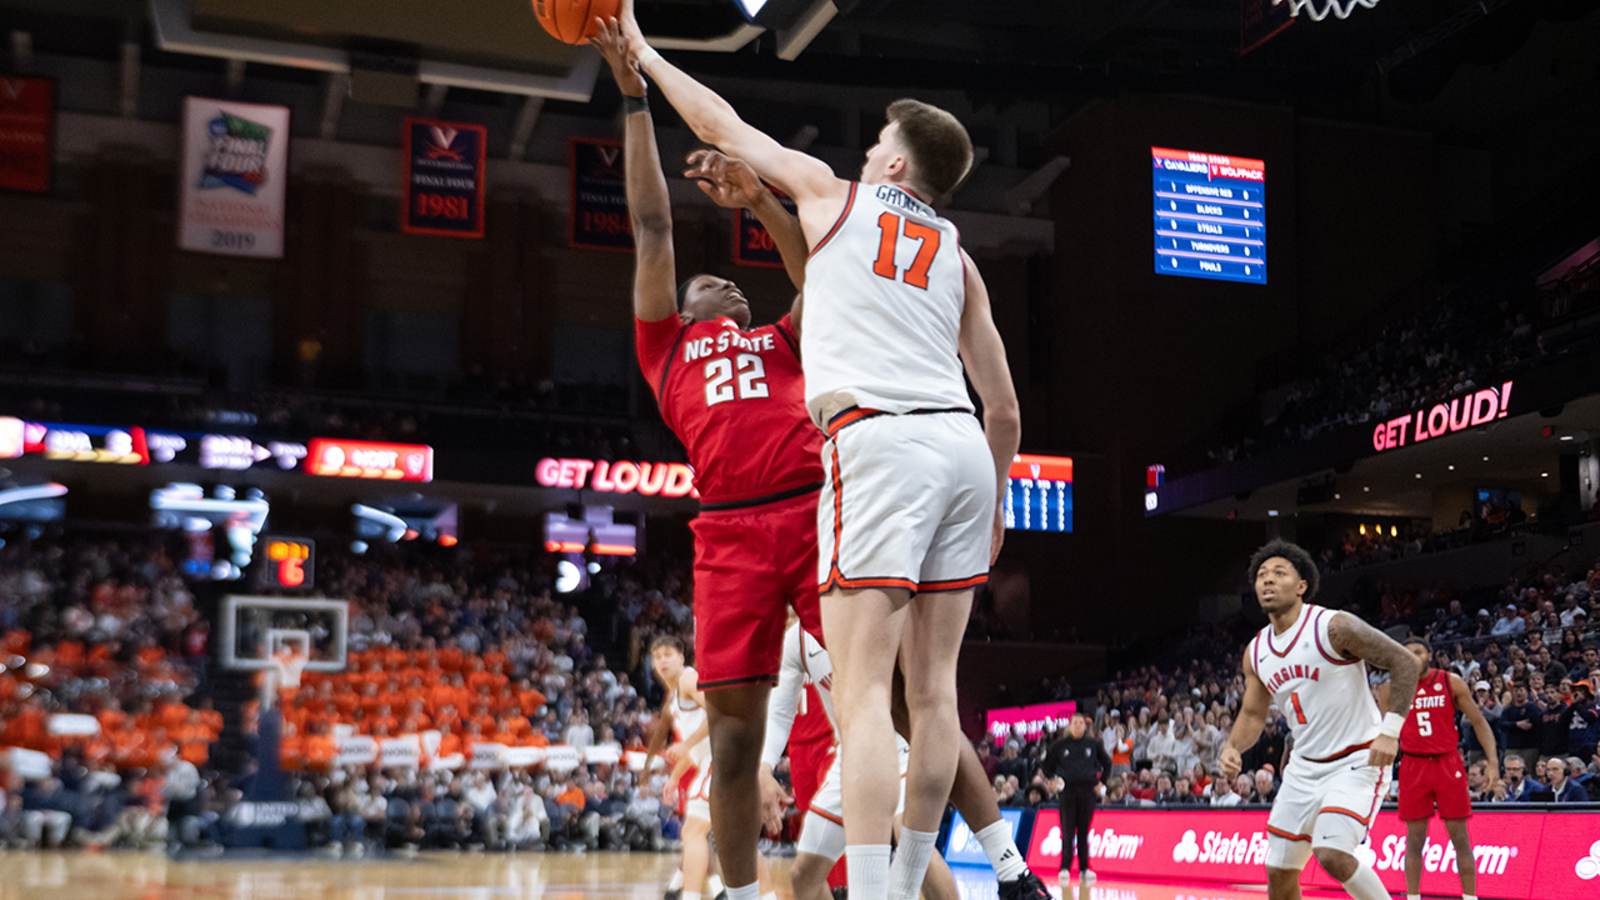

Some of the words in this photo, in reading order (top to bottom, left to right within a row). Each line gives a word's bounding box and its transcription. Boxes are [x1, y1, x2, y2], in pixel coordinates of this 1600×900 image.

[209, 135, 266, 157] FINAL
[204, 152, 264, 173] FOUR
[1164, 159, 1208, 174] CAVALIERS
[1219, 166, 1264, 180] WOLFPACK
[413, 173, 446, 187] FINAL
[447, 177, 476, 190] FOUR
[1171, 181, 1176, 192] 1
[1185, 184, 1219, 196] OFFENSIVE
[1243, 190, 1249, 200] 0
[417, 193, 470, 219] 1981
[1170, 200, 1177, 211] 0
[1196, 204, 1223, 216] BLOCKS
[1243, 208, 1249, 219] 0
[1171, 219, 1177, 230] 0
[1197, 222, 1223, 234] STEALS
[1245, 227, 1249, 238] 1
[211, 229, 256, 250] 2019
[747, 227, 777, 252] 20
[1172, 238, 1177, 249] 1
[1191, 240, 1230, 254] TURNOVERS
[1244, 246, 1250, 257] 0
[872, 210, 941, 291] 17
[1171, 257, 1178, 268] 0
[1200, 260, 1222, 272] FOULS
[1244, 265, 1250, 276] 0
[684, 336, 715, 363] NC
[717, 330, 776, 353] STATE
[705, 351, 770, 408] 22
[1373, 414, 1412, 451] GET
[1414, 380, 1513, 442] LOUD!
[535, 457, 595, 489] GET
[592, 459, 700, 498] LOUD
[278, 557, 305, 587] 6
[1291, 692, 1308, 724] 1
[1415, 695, 1446, 709] STATE
[1416, 711, 1433, 737] 5
